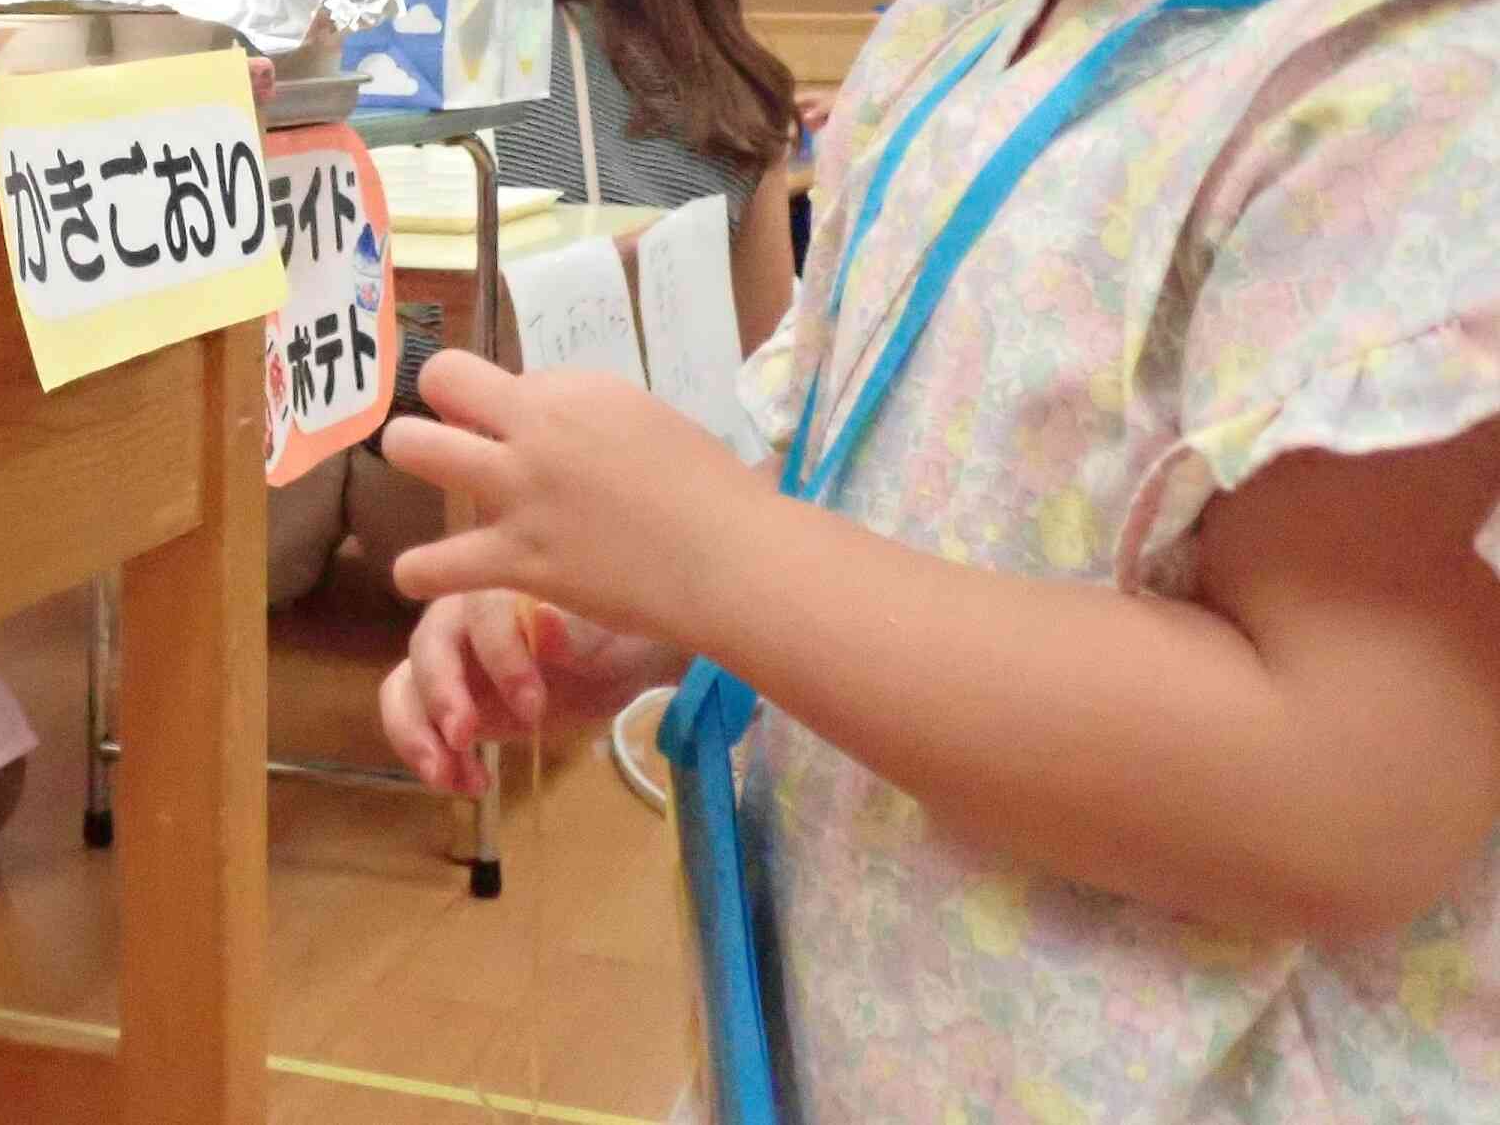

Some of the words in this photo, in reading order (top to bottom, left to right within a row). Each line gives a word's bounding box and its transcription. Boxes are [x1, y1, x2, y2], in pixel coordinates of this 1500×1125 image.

[5, 140, 265, 284] かきごおり
[287, 303, 377, 417] ポテト
